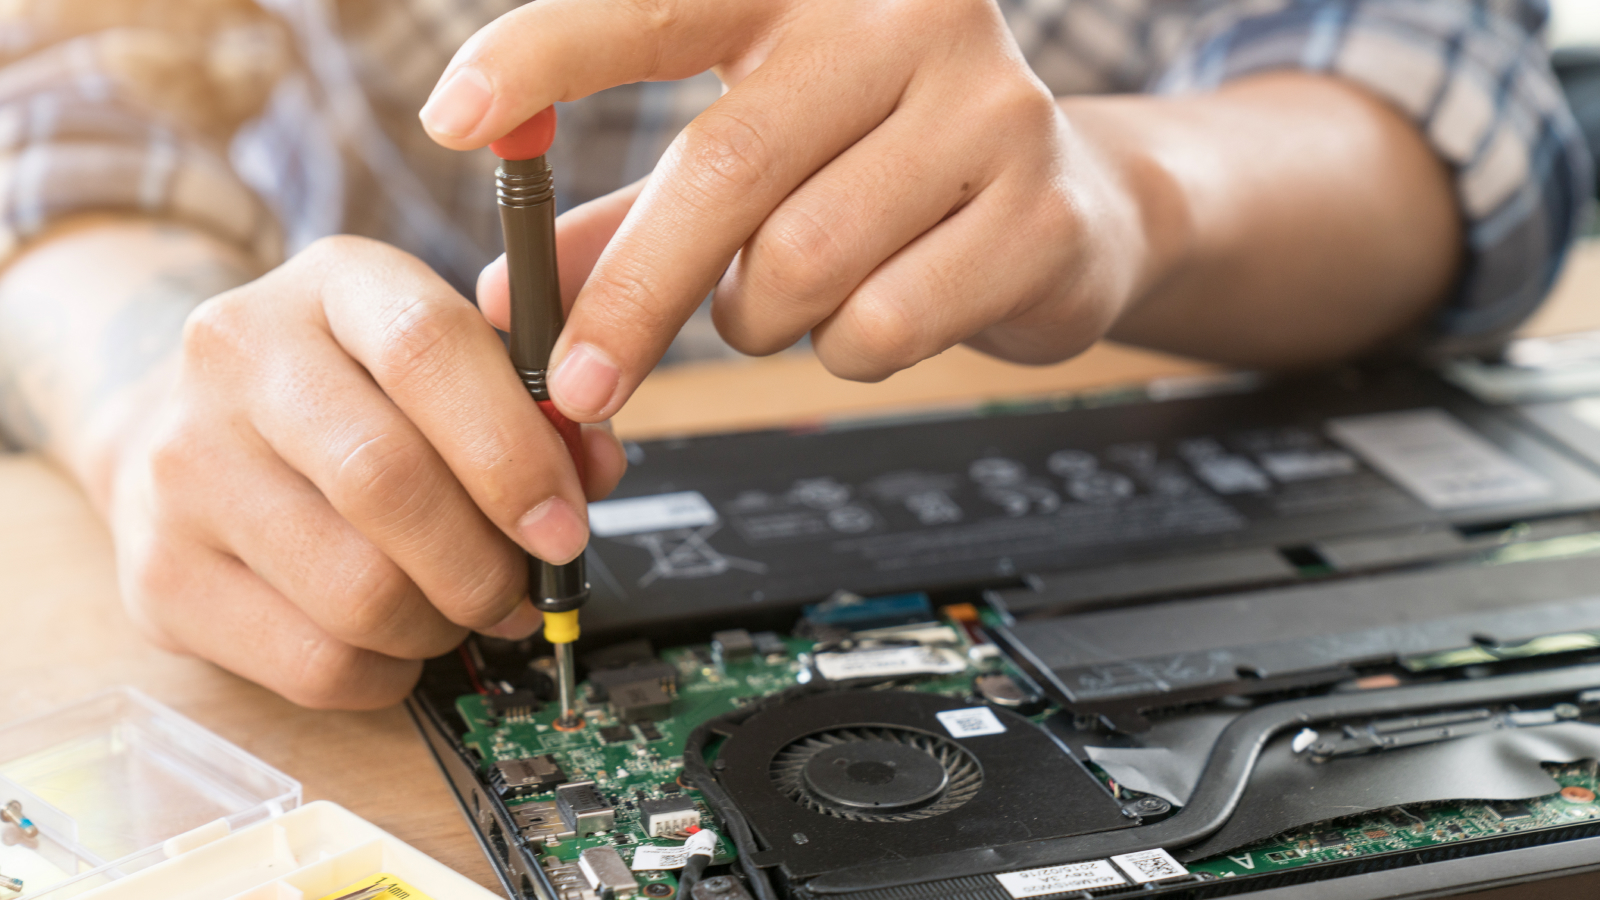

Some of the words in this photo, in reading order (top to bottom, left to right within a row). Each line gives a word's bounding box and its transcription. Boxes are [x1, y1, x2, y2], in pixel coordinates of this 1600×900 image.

[1226, 852, 1255, 870] A
[1020, 863, 1098, 879] 2015/02/16
[1065, 871, 1095, 879] Rev
